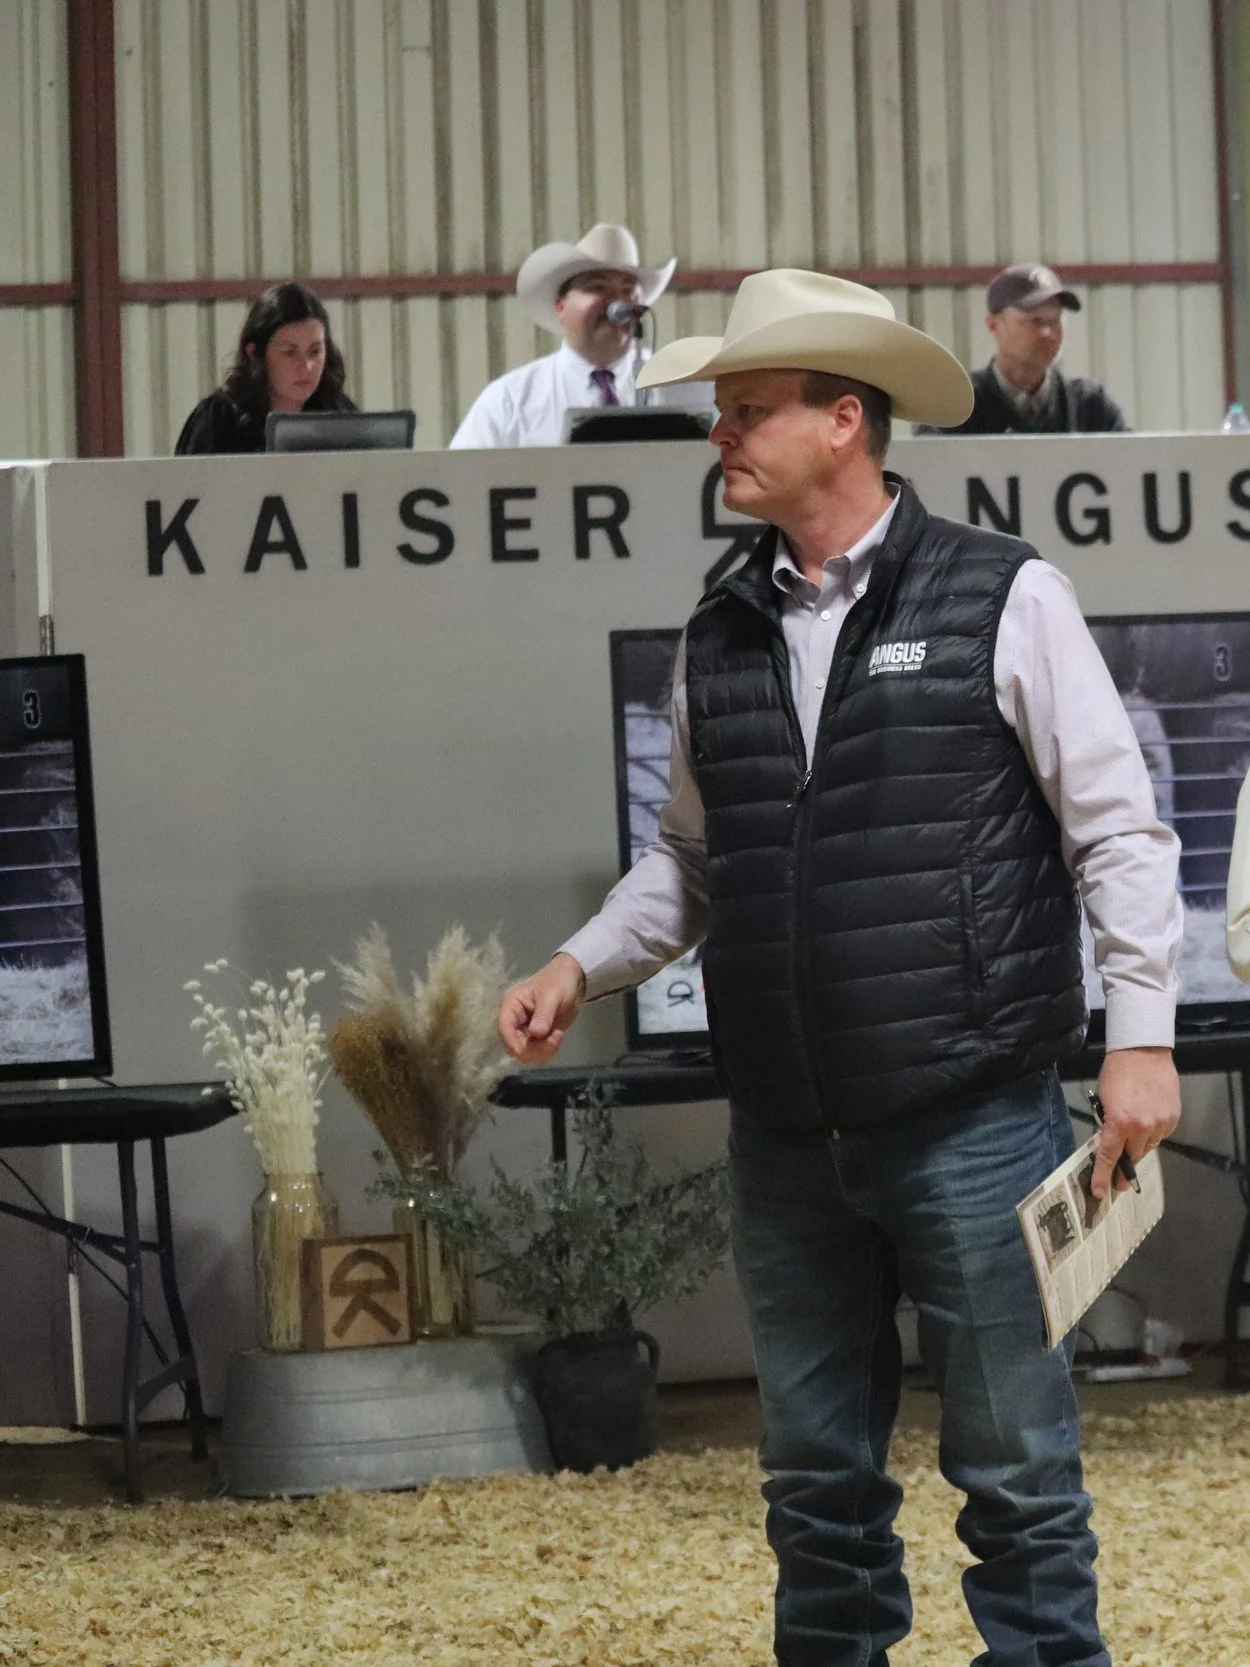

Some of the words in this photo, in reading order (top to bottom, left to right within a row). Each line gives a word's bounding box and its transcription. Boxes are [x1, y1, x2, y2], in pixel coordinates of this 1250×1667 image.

[145, 485, 632, 577] KAISER
[868, 641, 927, 668] ANGUS
[1213, 643, 1232, 681] 3
[22, 689, 41, 729] 3
